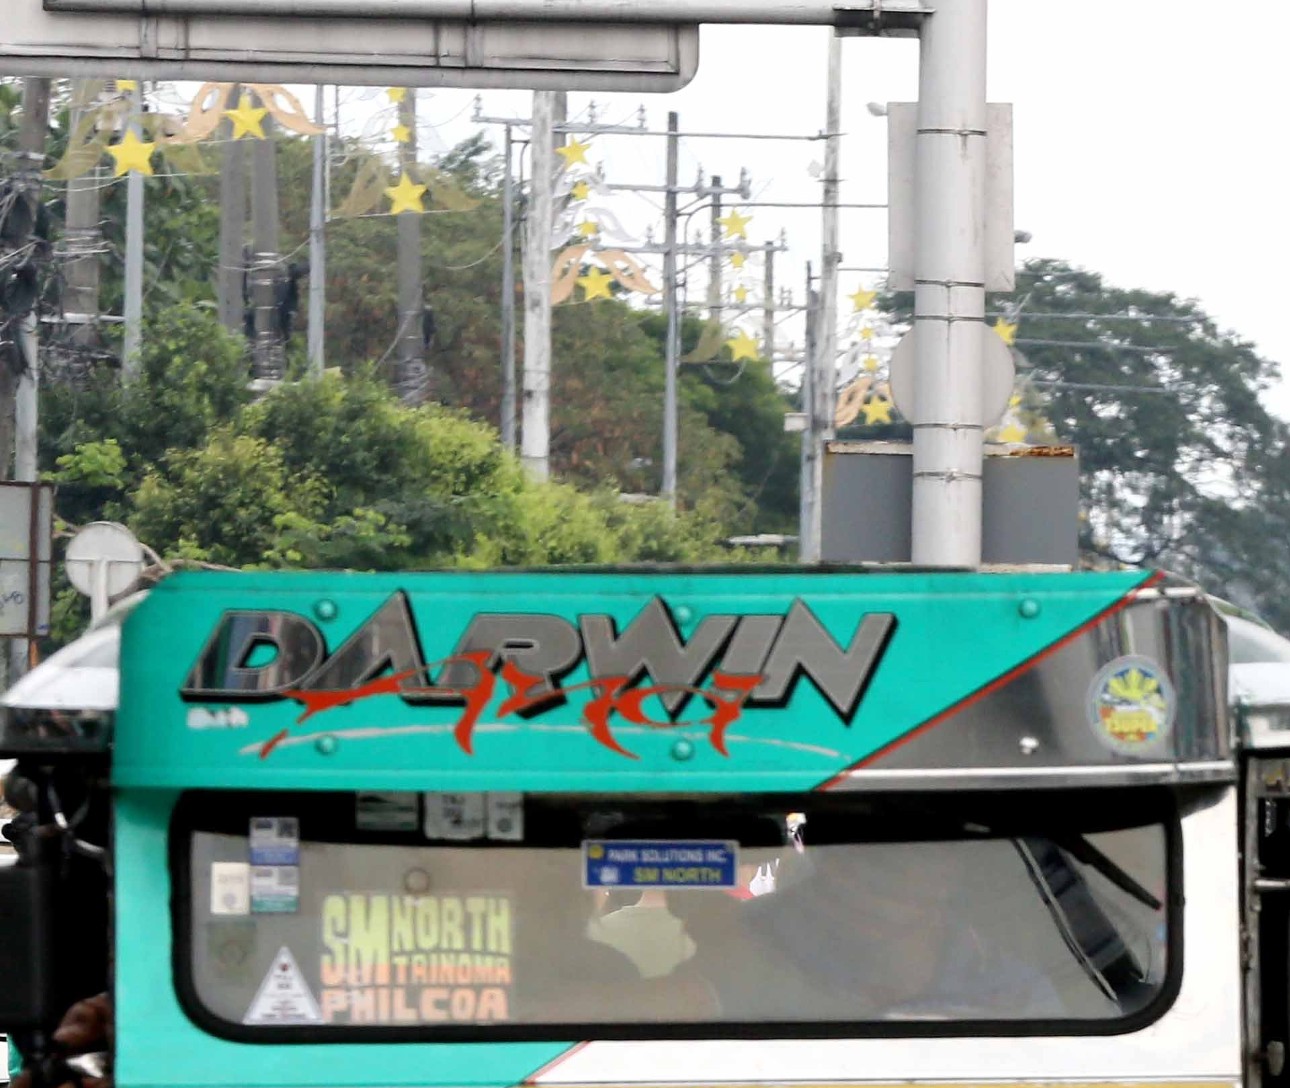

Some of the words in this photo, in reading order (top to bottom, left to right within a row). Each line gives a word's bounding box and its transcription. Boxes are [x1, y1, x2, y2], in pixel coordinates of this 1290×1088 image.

[179, 588, 898, 728] DARWIN
[661, 867, 722, 883] NORTH
[320, 895, 391, 986] SM
[392, 896, 512, 952] NORTH
[320, 986, 510, 1023] PHILCOA
